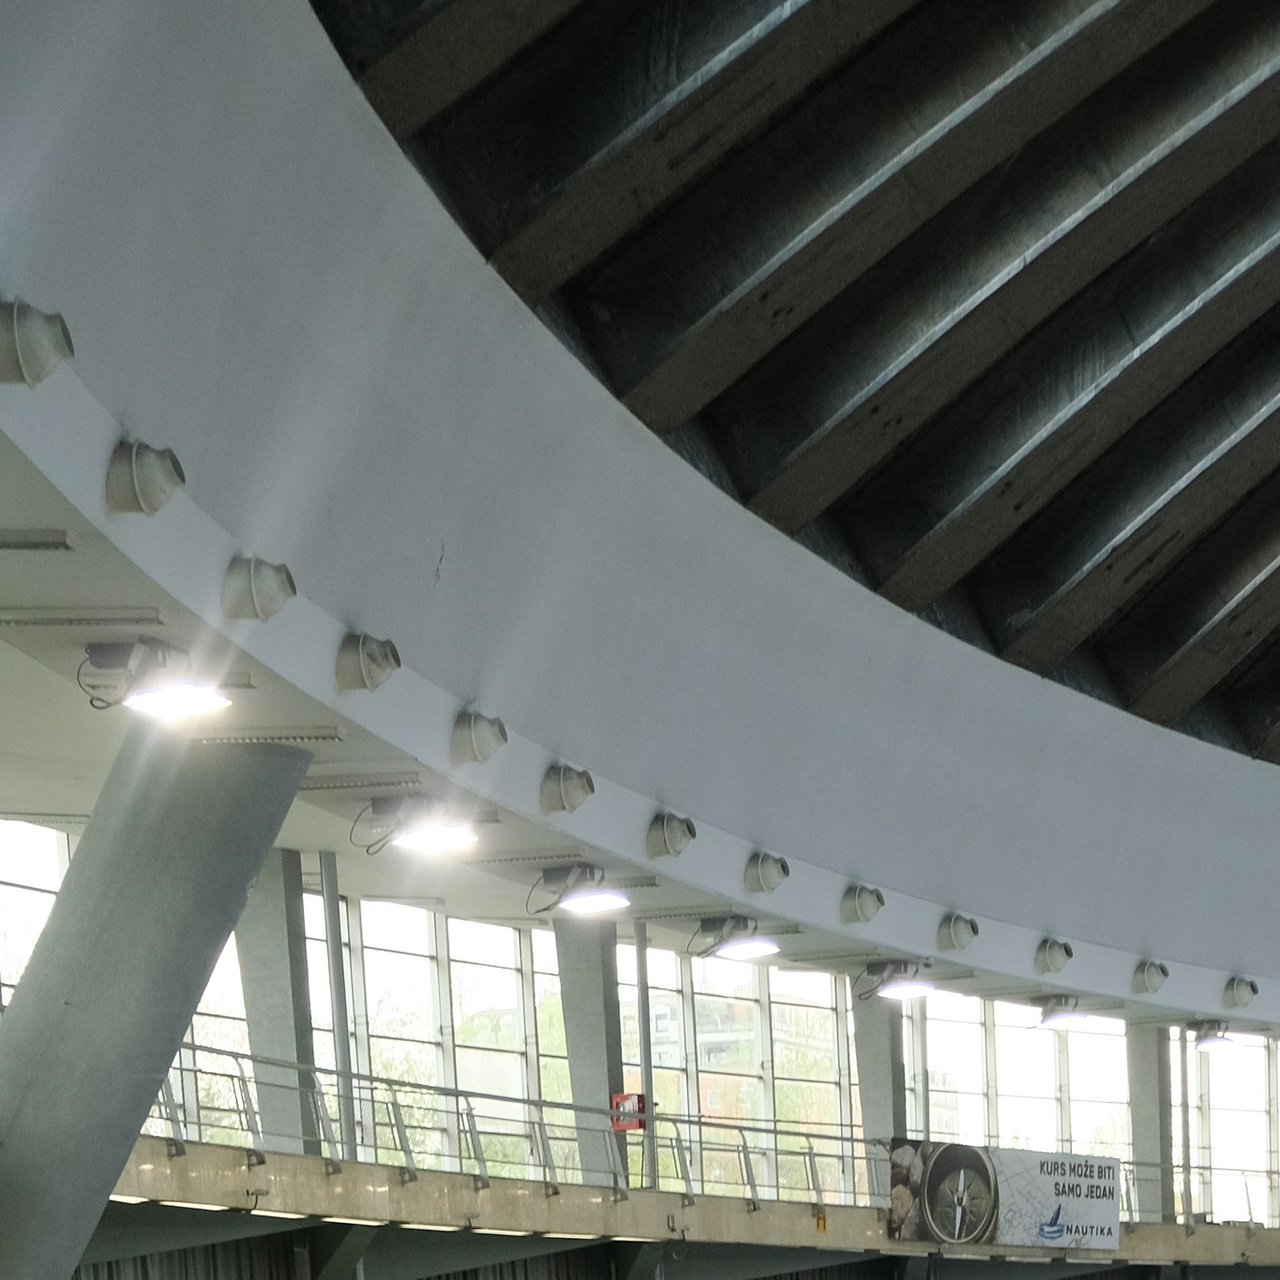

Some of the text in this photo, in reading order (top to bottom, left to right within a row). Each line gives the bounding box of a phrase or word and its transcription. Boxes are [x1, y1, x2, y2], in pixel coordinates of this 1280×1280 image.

[1040, 1160, 1115, 1181] KURS MOŽE BITI
[1054, 1182, 1115, 1201] SAMO JEDAN
[1066, 1224, 1113, 1238] NAUTIKA
